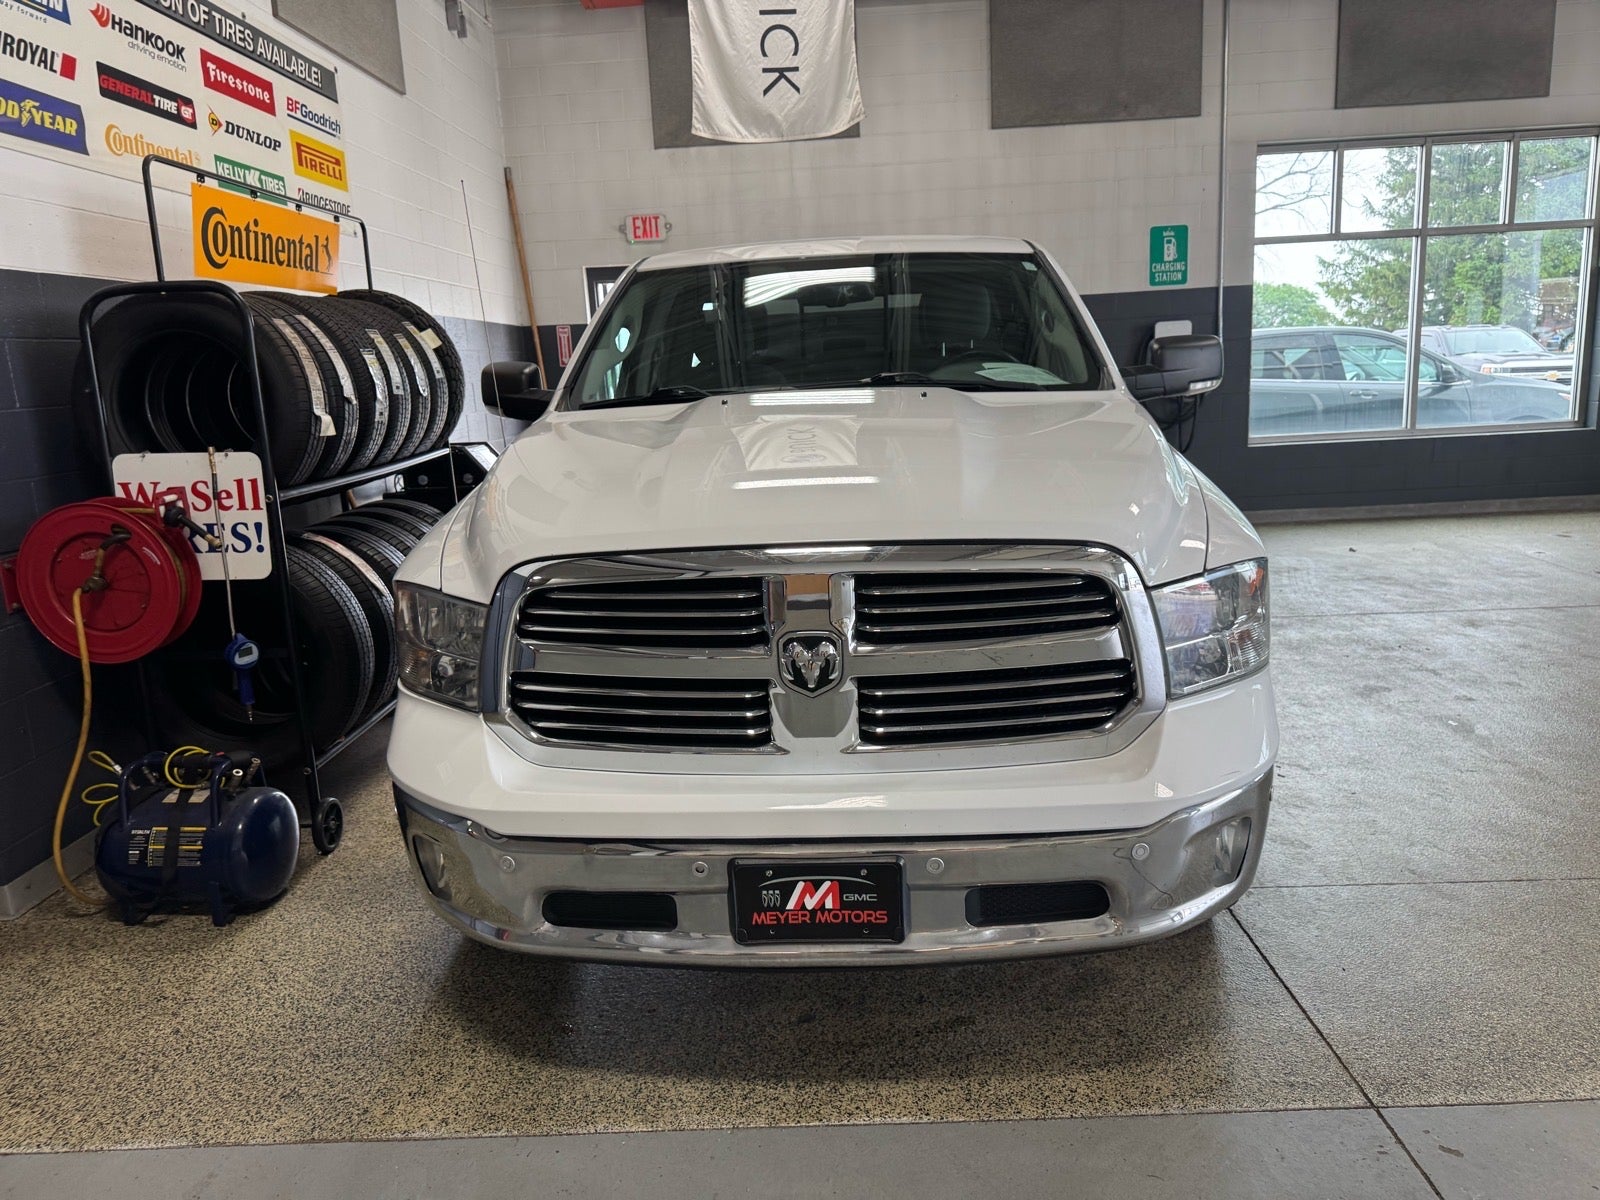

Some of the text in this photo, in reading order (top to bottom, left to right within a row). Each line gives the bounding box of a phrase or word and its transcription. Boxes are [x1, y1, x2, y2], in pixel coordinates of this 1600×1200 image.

[127, 40, 187, 73] driving emotion
[187, 0, 322, 88] OF TIRES AVAILABLE!
[759, 8, 801, 98] ICK
[207, 61, 271, 104] Firestone
[286, 96, 342, 135] BFGoodrich
[224, 120, 282, 152] DUNLOP
[216, 160, 286, 196] KELLY TIRES
[295, 141, 343, 182] PIRELLI
[201, 206, 320, 274] Continental
[632, 215, 661, 240] EXIT
[1152, 262, 1185, 272] CHARGING
[1154, 272, 1182, 282] STATION
[190, 477, 264, 512] Sell
[843, 893, 878, 902] GMC
[752, 910, 888, 926] MEYER MOTORS
